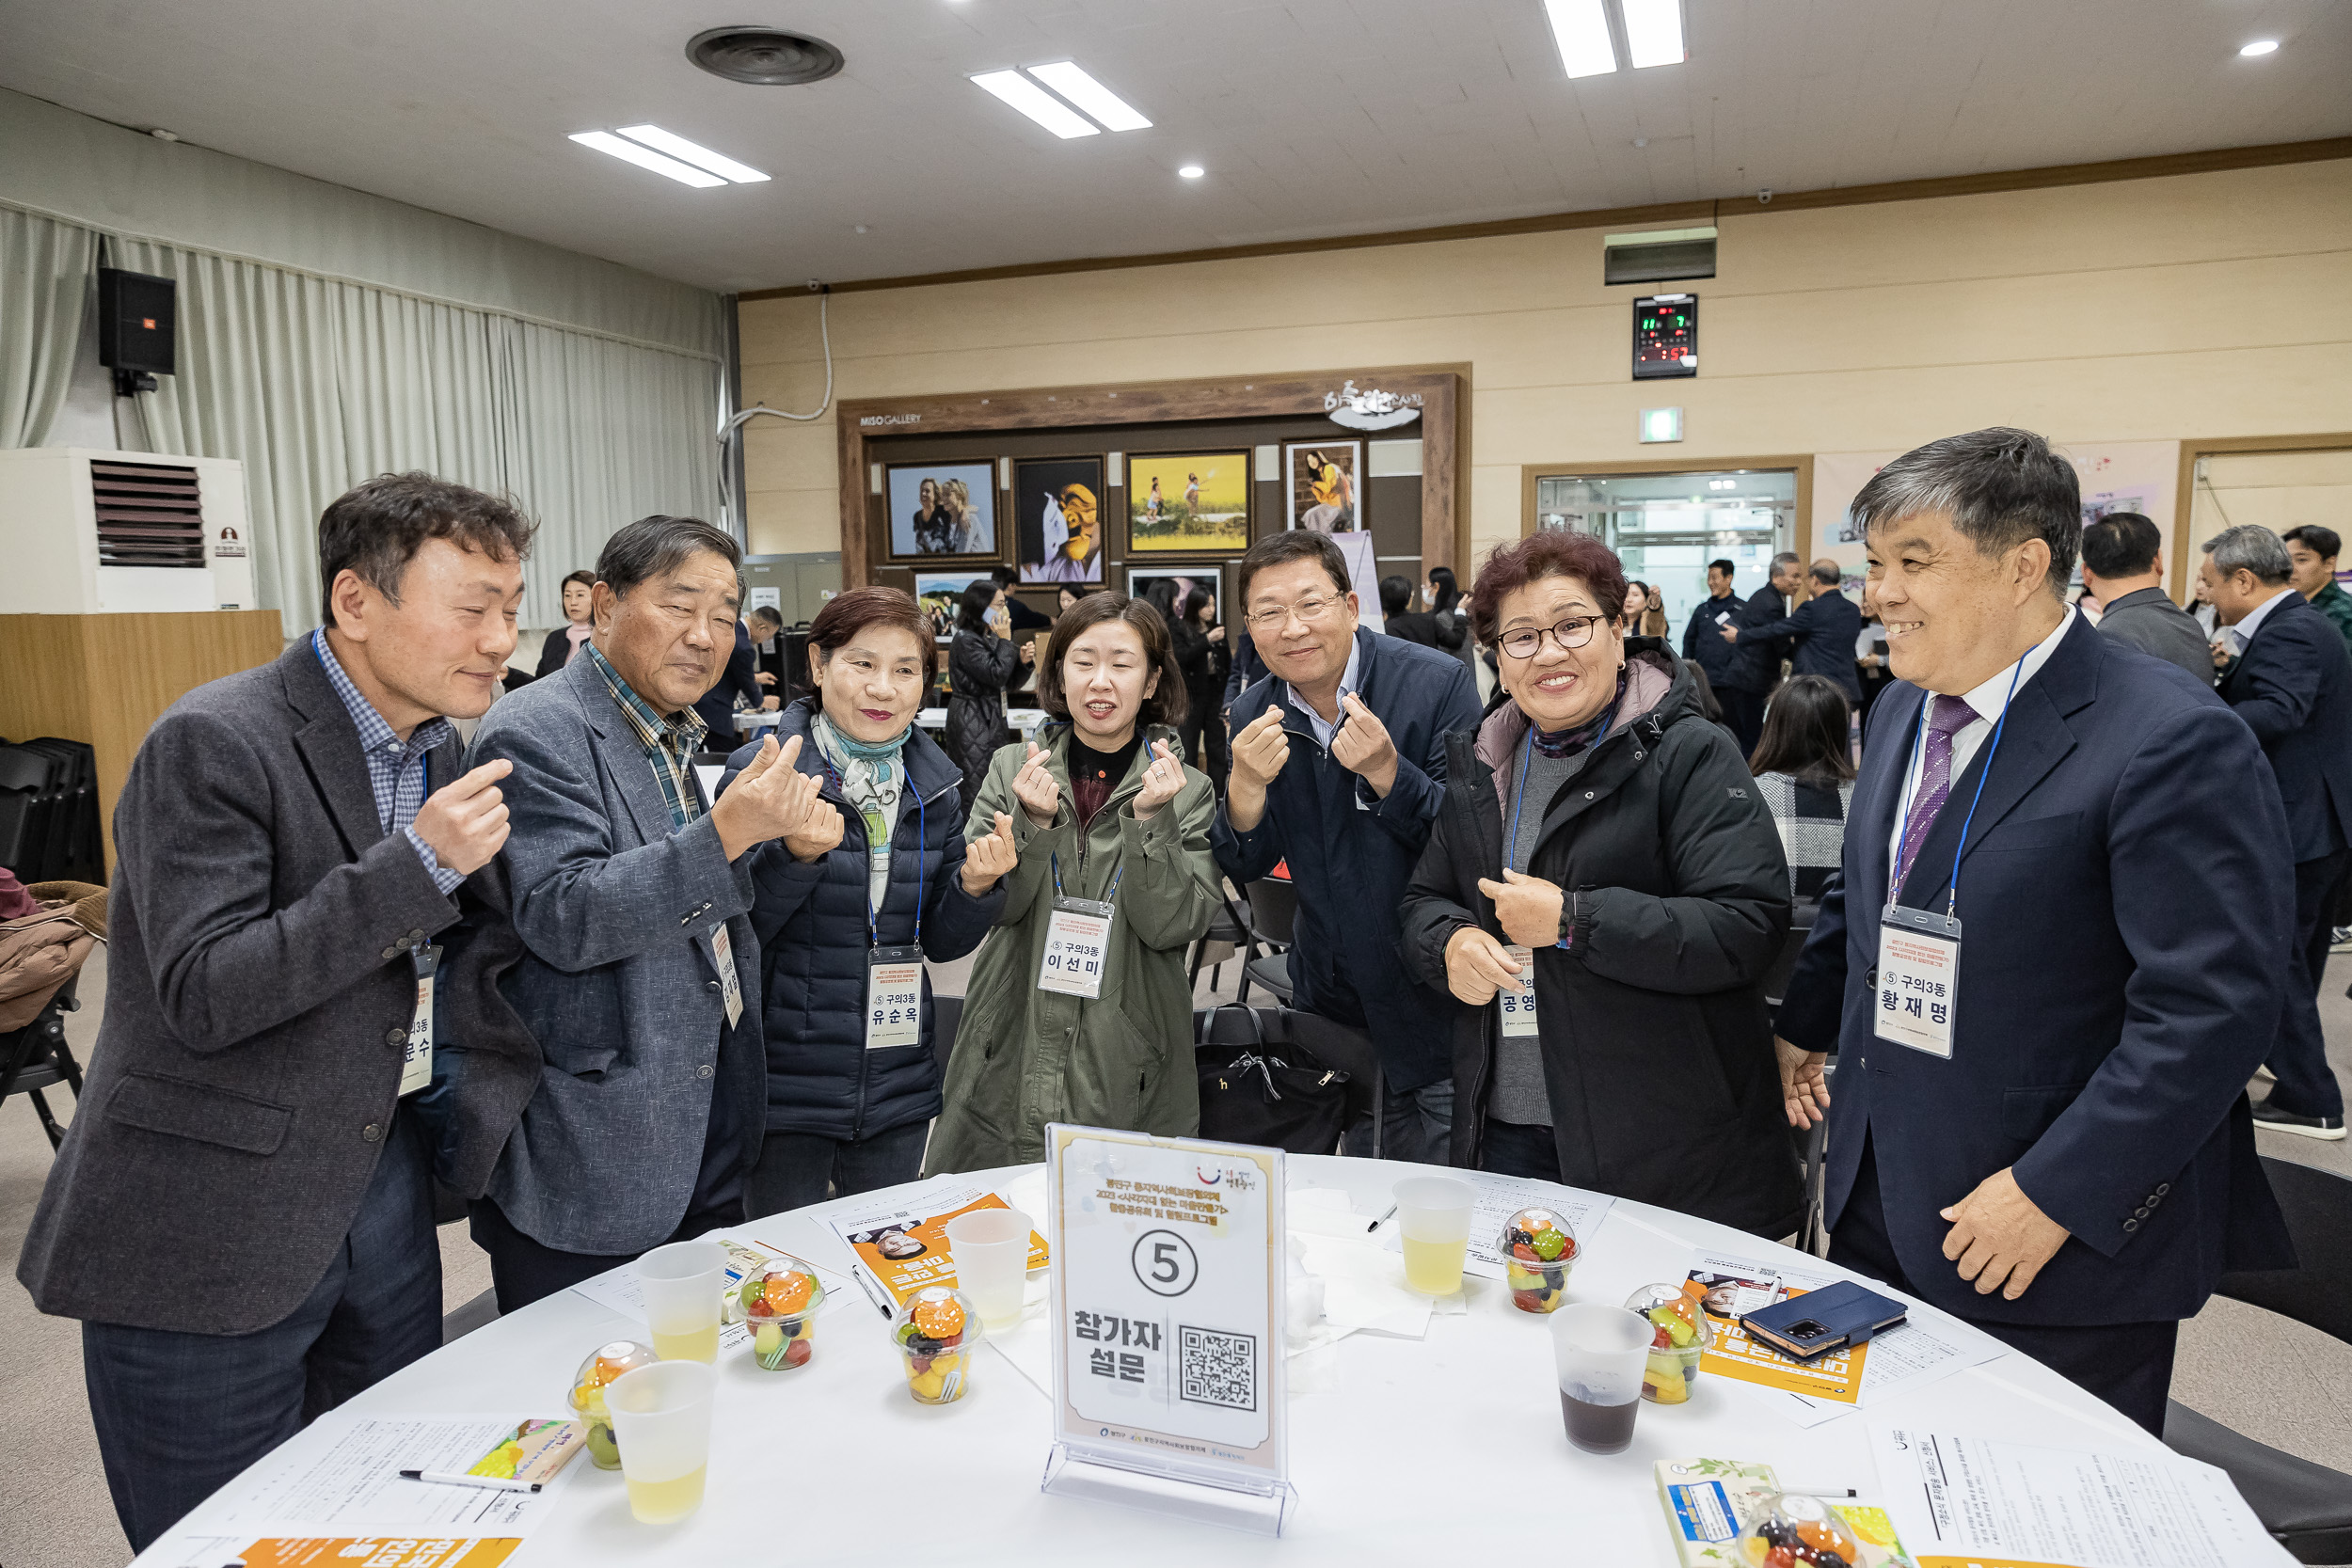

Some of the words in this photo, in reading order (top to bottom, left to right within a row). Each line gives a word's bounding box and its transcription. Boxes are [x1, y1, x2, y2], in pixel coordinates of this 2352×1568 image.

[884, 414, 922, 425] GALLERY
[1065, 942, 1099, 958] 구의3동
[1901, 974, 1946, 997] 구의3동
[886, 992, 915, 1005] 구의3동
[1106, 1179, 1132, 1190] 광진구
[1075, 1310, 1162, 1352] 참가자
[1090, 1348, 1145, 1384] 설문
